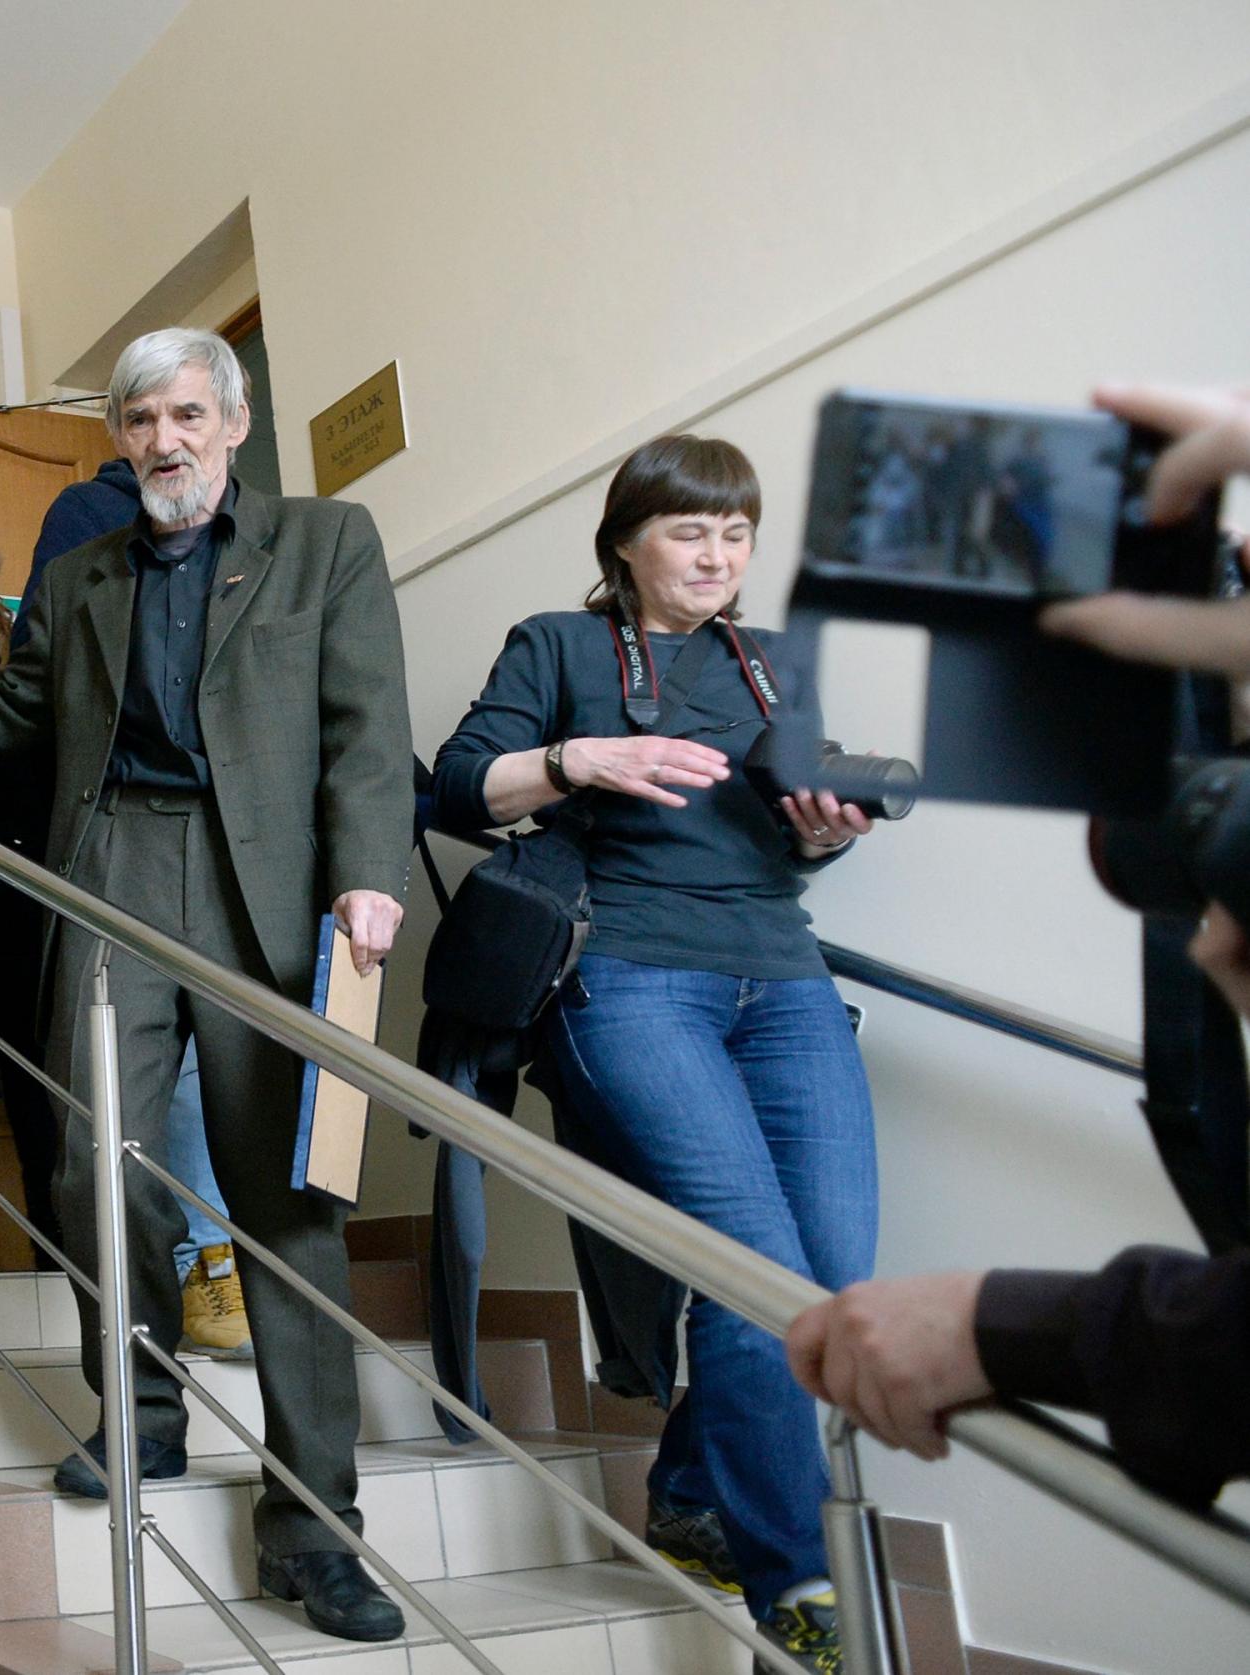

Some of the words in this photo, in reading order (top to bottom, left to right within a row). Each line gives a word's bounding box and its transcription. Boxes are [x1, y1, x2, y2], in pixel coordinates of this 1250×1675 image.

[326, 425, 334, 442] 3
[337, 389, 384, 433] ЭТАЖ
[621, 625, 636, 643] EOS
[628, 644, 644, 690] DIGITAL
[750, 659, 779, 704] Canon
